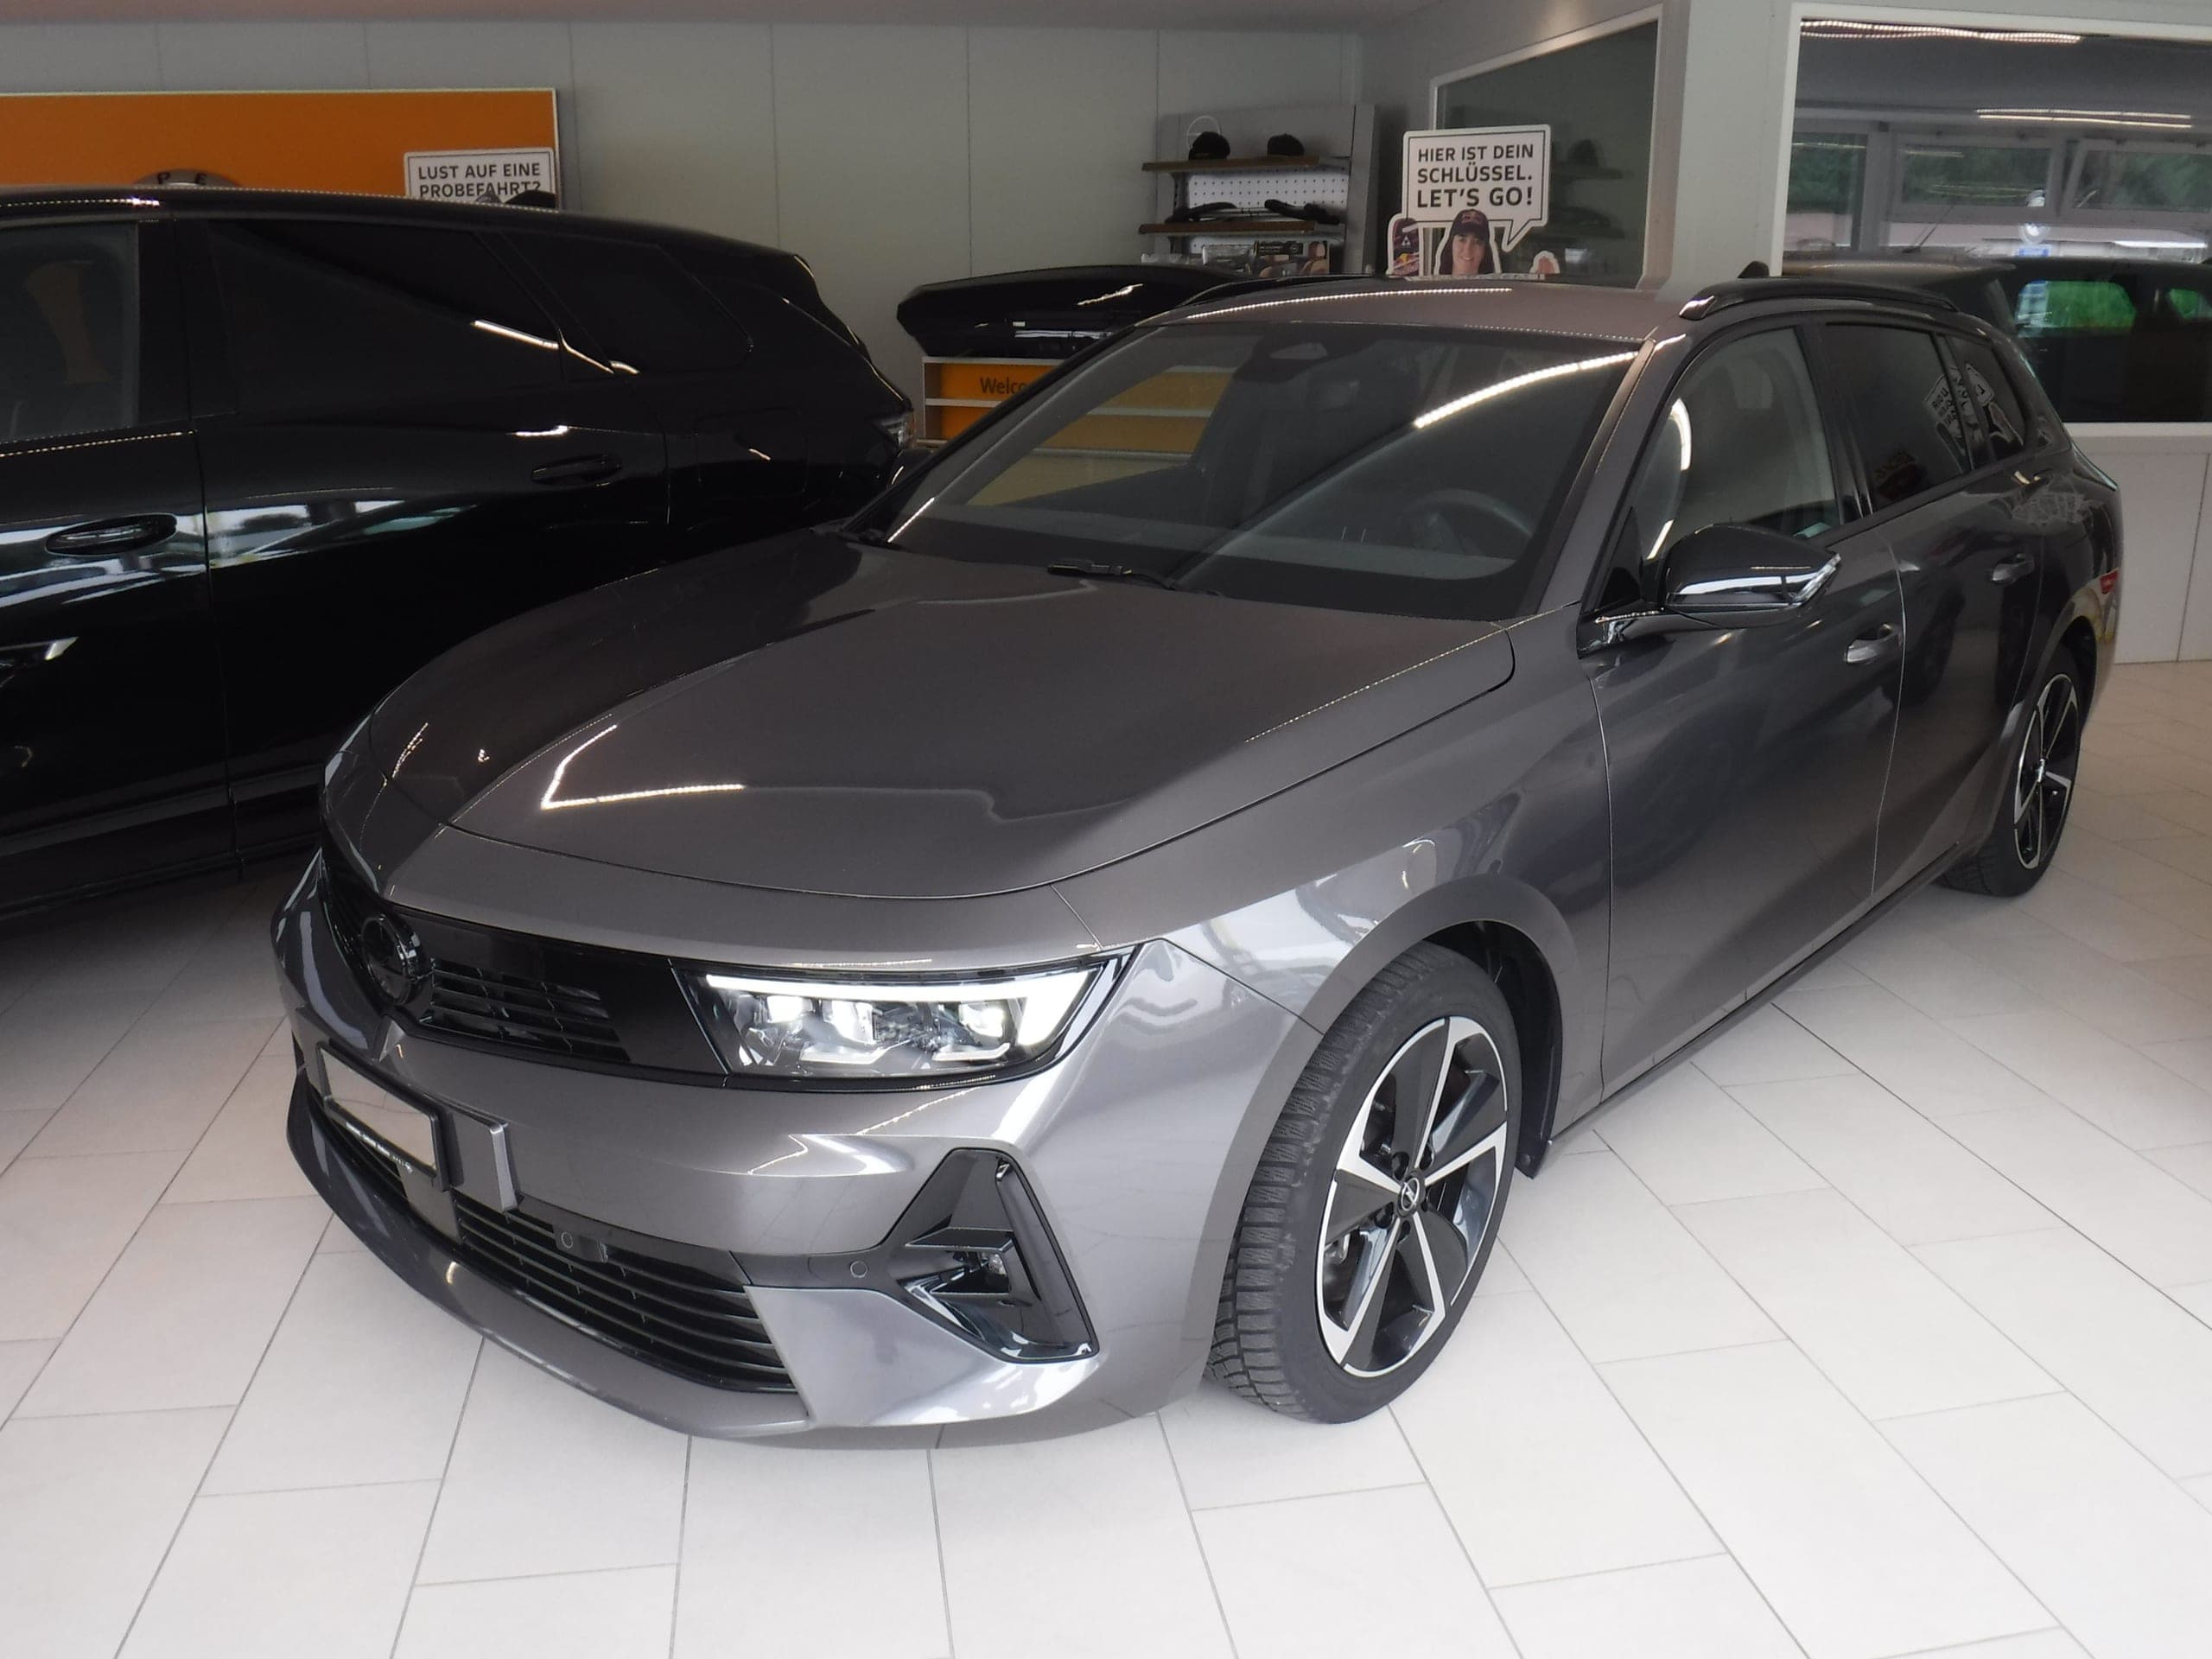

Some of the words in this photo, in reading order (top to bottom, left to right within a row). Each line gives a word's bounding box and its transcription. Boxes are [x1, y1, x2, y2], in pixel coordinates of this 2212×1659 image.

[1419, 148, 1456, 162] HIER
[1461, 146, 1488, 161] IST
[1493, 143, 1534, 159] DEIN
[418, 166, 458, 180] LUST
[465, 164, 497, 178] AUF
[503, 162, 540, 176] EINE
[1418, 162, 1532, 183] SCHLÜSSEL.
[1417, 188, 1480, 208] LET'S
[1489, 187, 1533, 207] GO!
